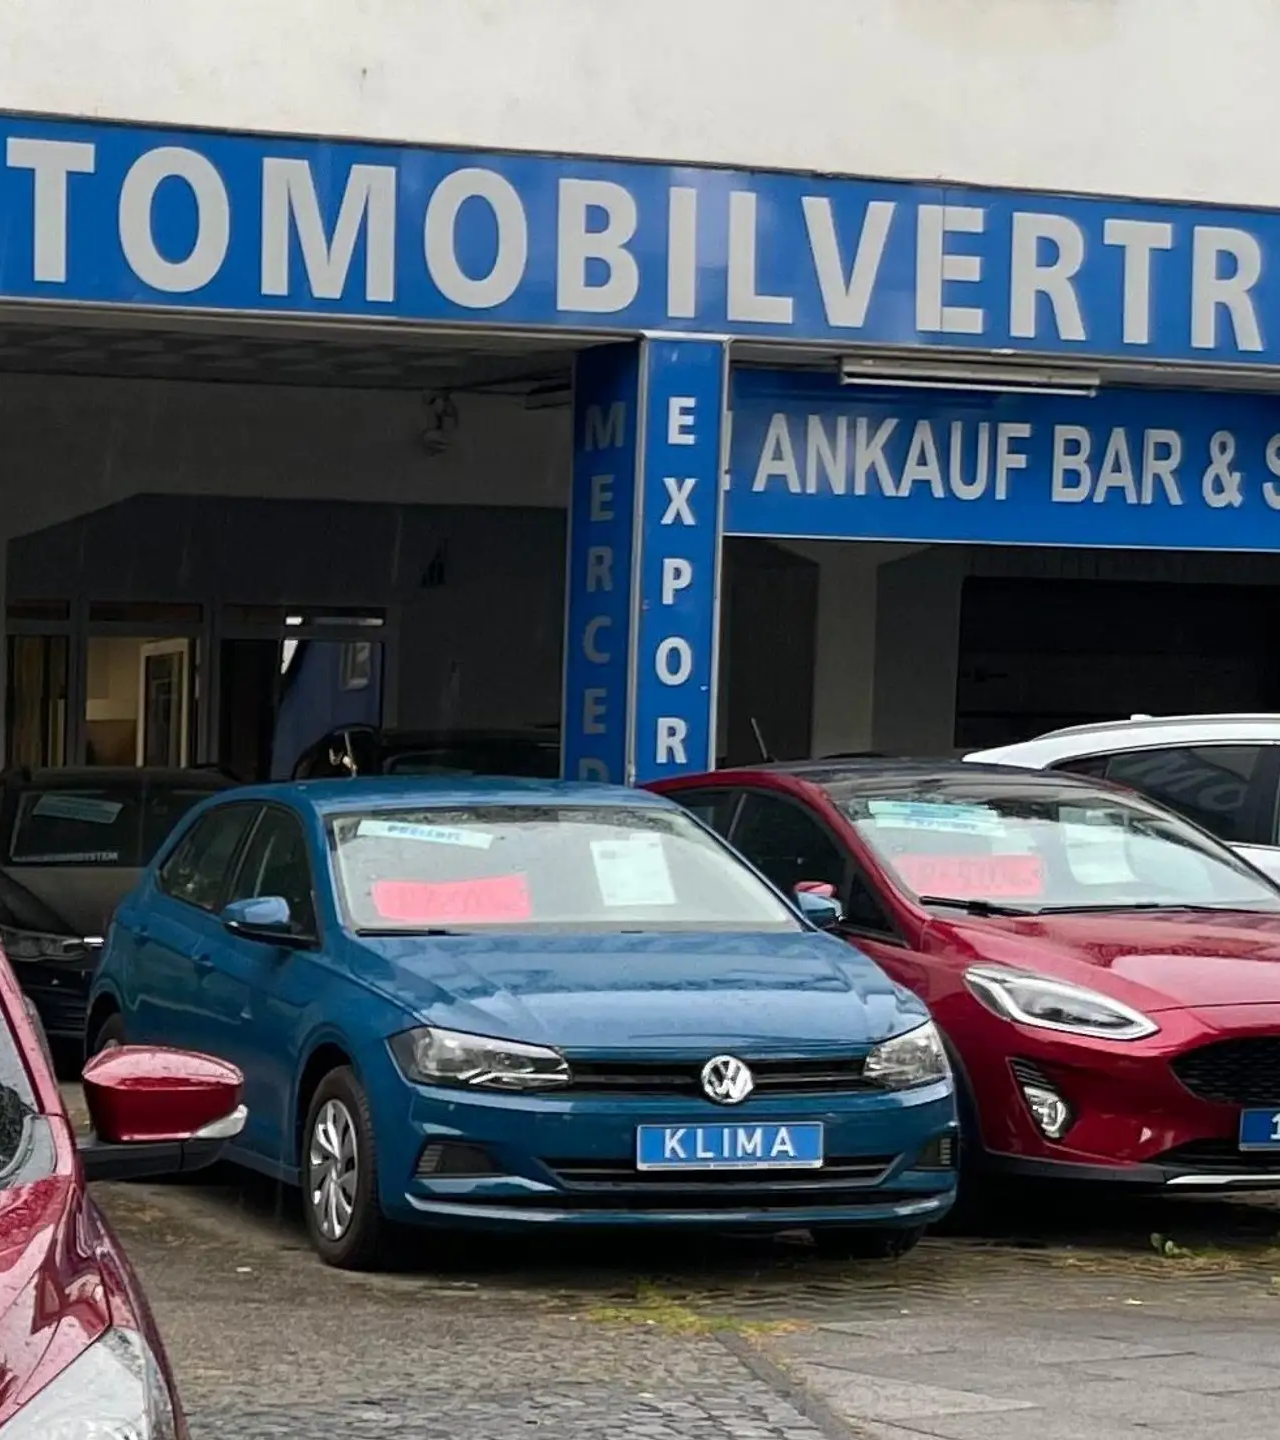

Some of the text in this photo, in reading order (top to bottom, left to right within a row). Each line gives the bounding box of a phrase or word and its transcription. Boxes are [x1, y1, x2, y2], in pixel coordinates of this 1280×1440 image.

[752, 413, 1031, 500] ANKAUF
[1052, 424, 1183, 505] BAR
[1202, 430, 1243, 508] &
[664, 1127, 798, 1159] KLIMA
